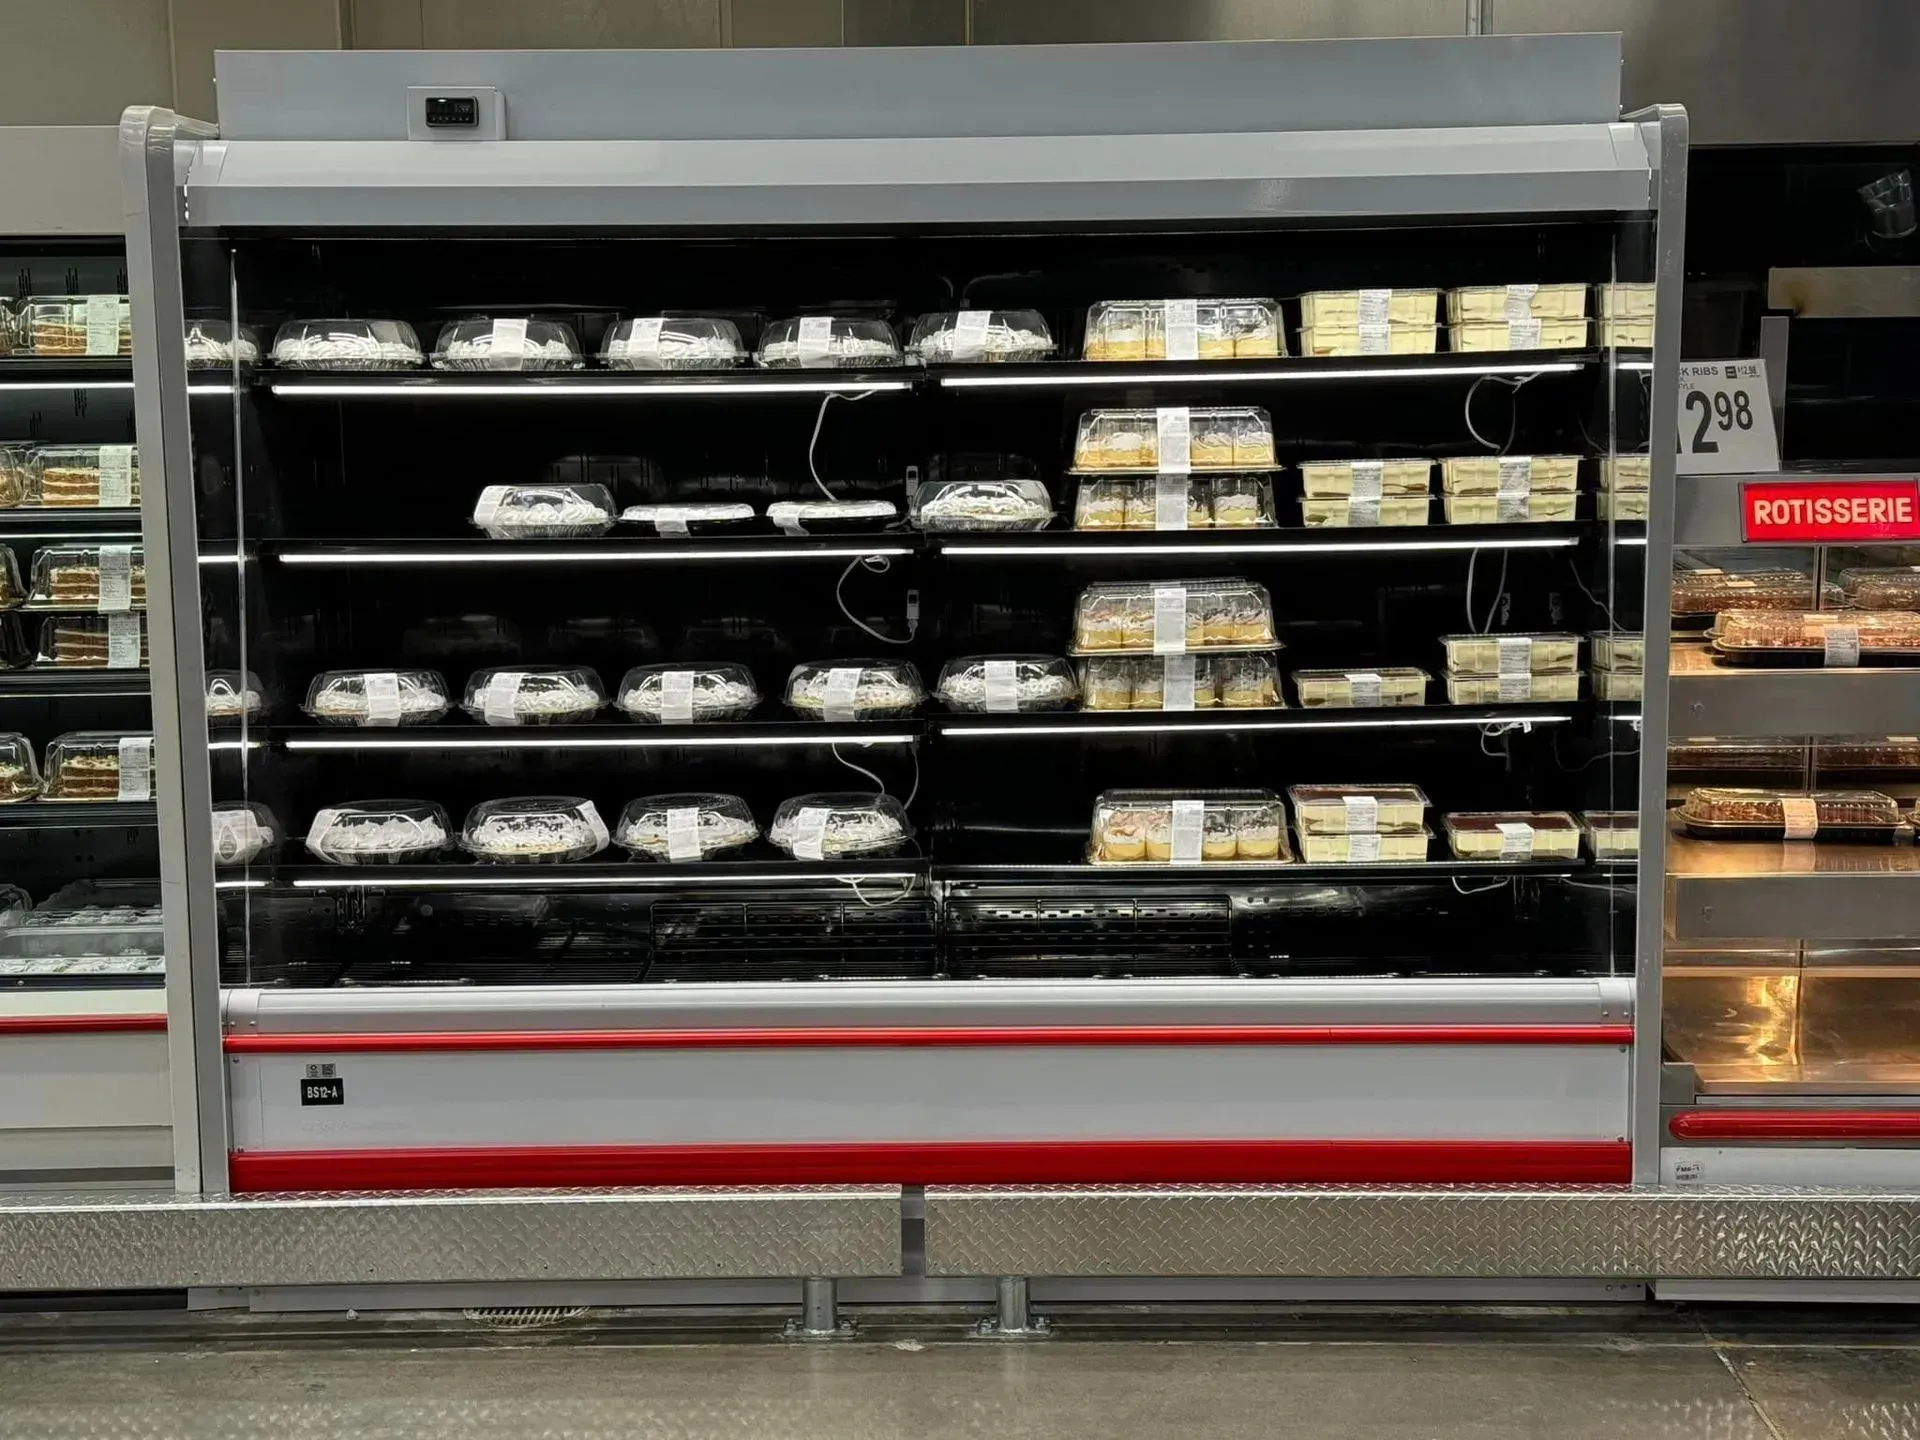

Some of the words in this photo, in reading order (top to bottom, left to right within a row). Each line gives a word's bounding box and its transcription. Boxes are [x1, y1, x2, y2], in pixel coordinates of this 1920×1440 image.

[1692, 366, 1719, 376] RIBS
[1753, 497, 1913, 526] ROTISSERIE
[307, 1086, 338, 1099] BS12-A
